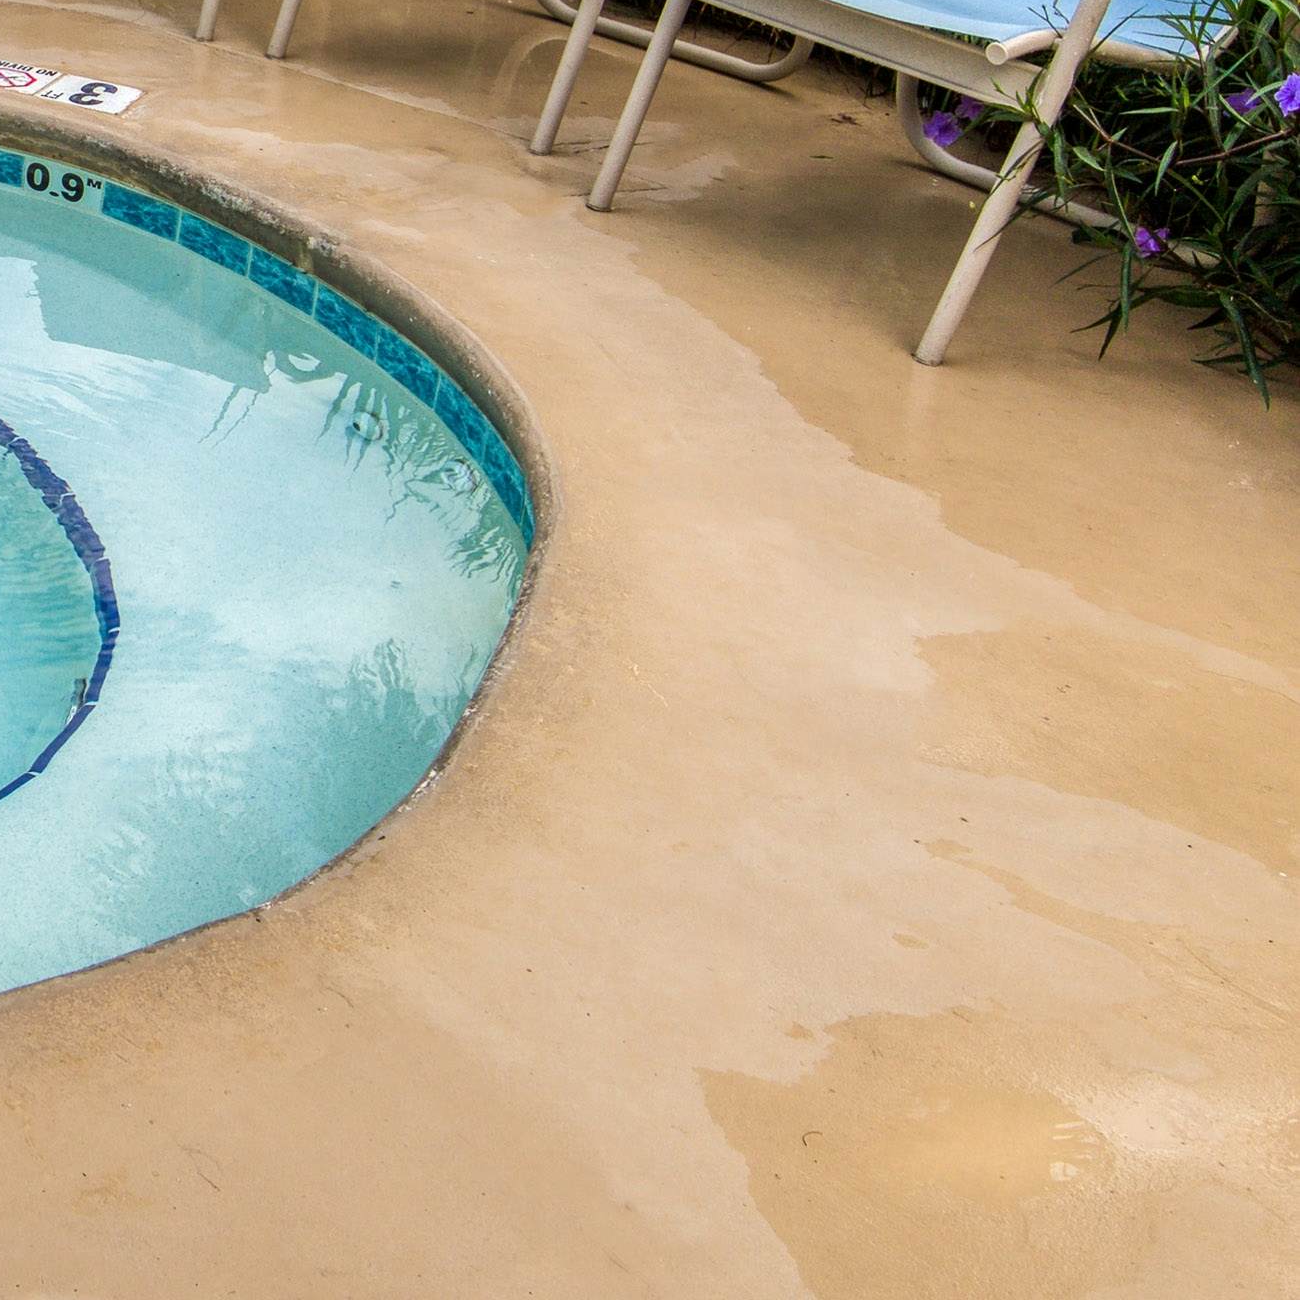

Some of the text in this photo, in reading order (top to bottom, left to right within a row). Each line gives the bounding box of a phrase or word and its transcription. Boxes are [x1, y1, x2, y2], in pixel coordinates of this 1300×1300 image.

[36, 68, 58, 77] NO
[41, 82, 118, 106] 3 FT
[26, 162, 102, 203] 0.9 M
